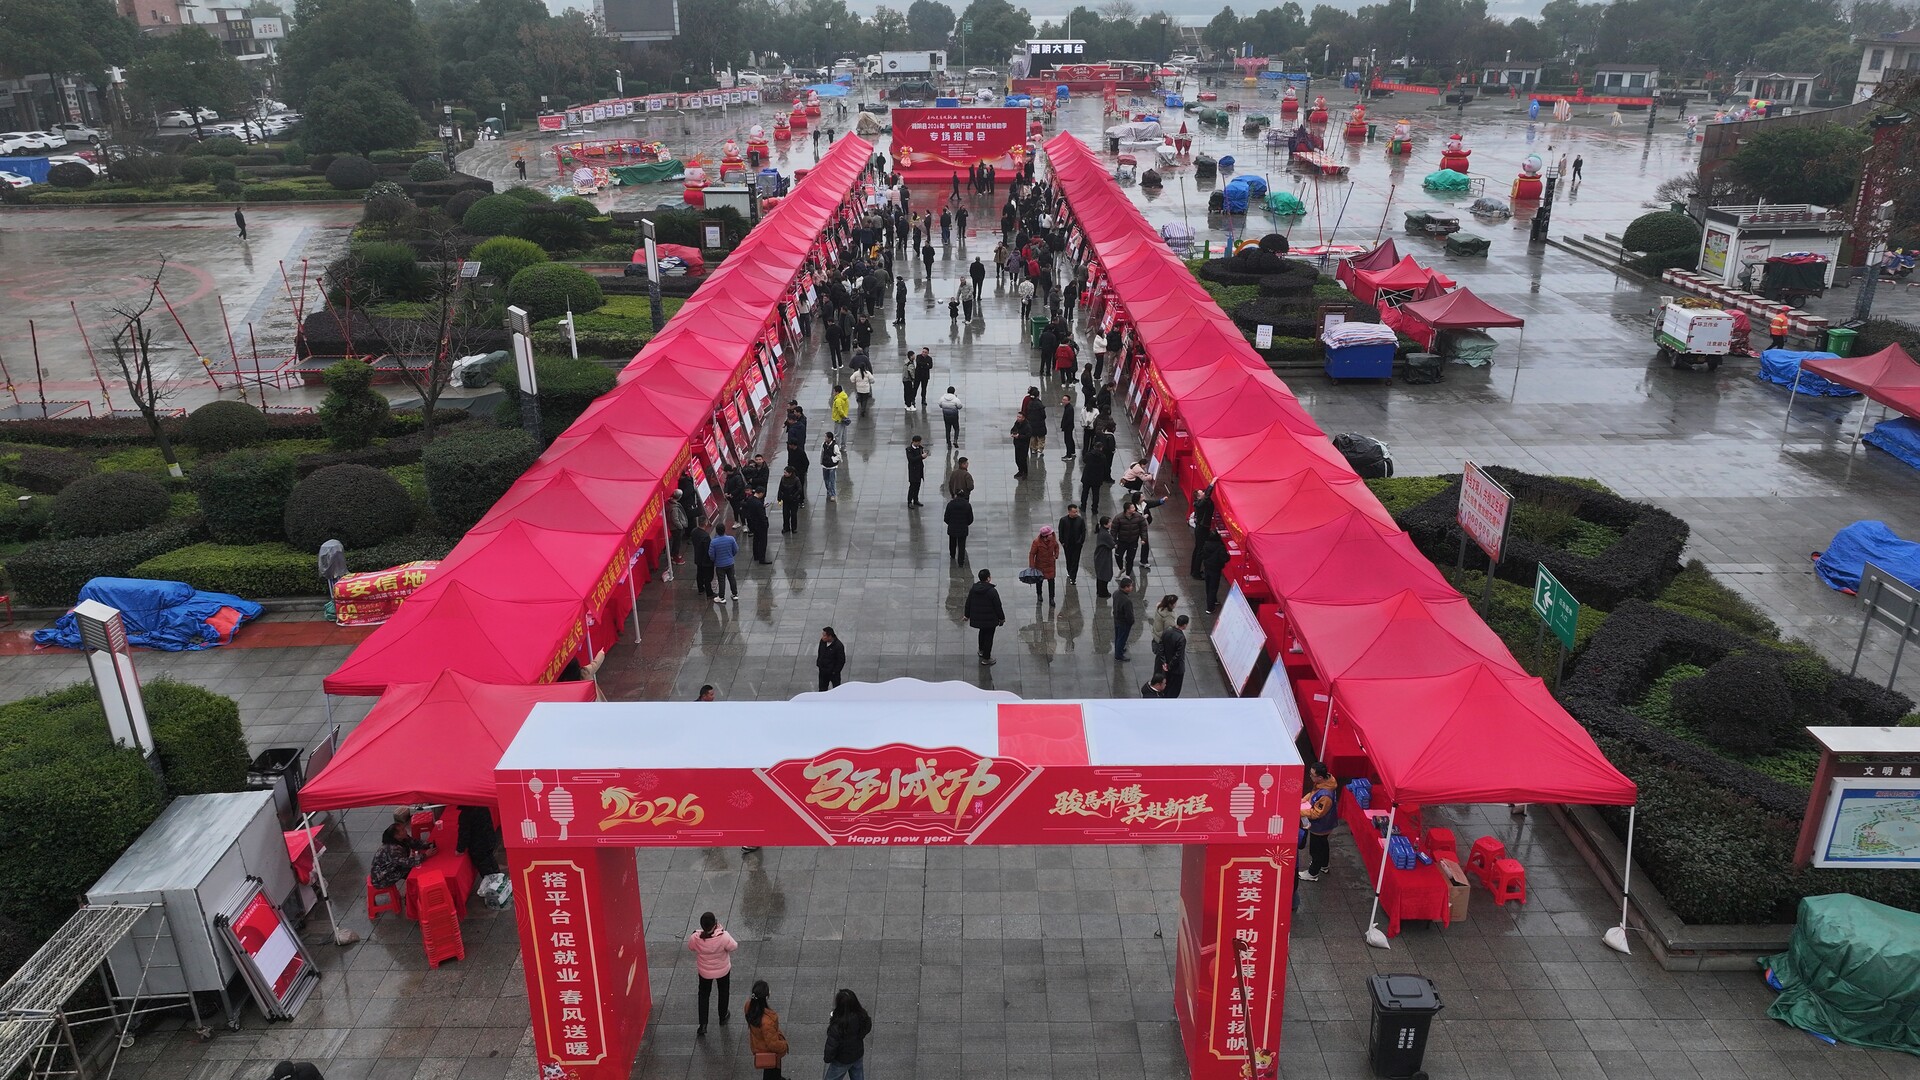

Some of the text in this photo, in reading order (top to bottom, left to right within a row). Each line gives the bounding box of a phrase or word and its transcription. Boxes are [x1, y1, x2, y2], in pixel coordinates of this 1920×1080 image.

[929, 131, 986, 141] 专场招聘会
[591, 547, 628, 612] 工伤政策宣传
[802, 757, 1001, 832] 马到成功
[1863, 766, 1912, 776] 文明城
[598, 785, 706, 832] 2026
[1120, 793, 1214, 833] 共赴新程
[847, 835, 953, 845] Happy new year
[1236, 868, 1263, 921] 聚英才
[541, 872, 590, 1056] 搭平台 促就业 春风送暖
